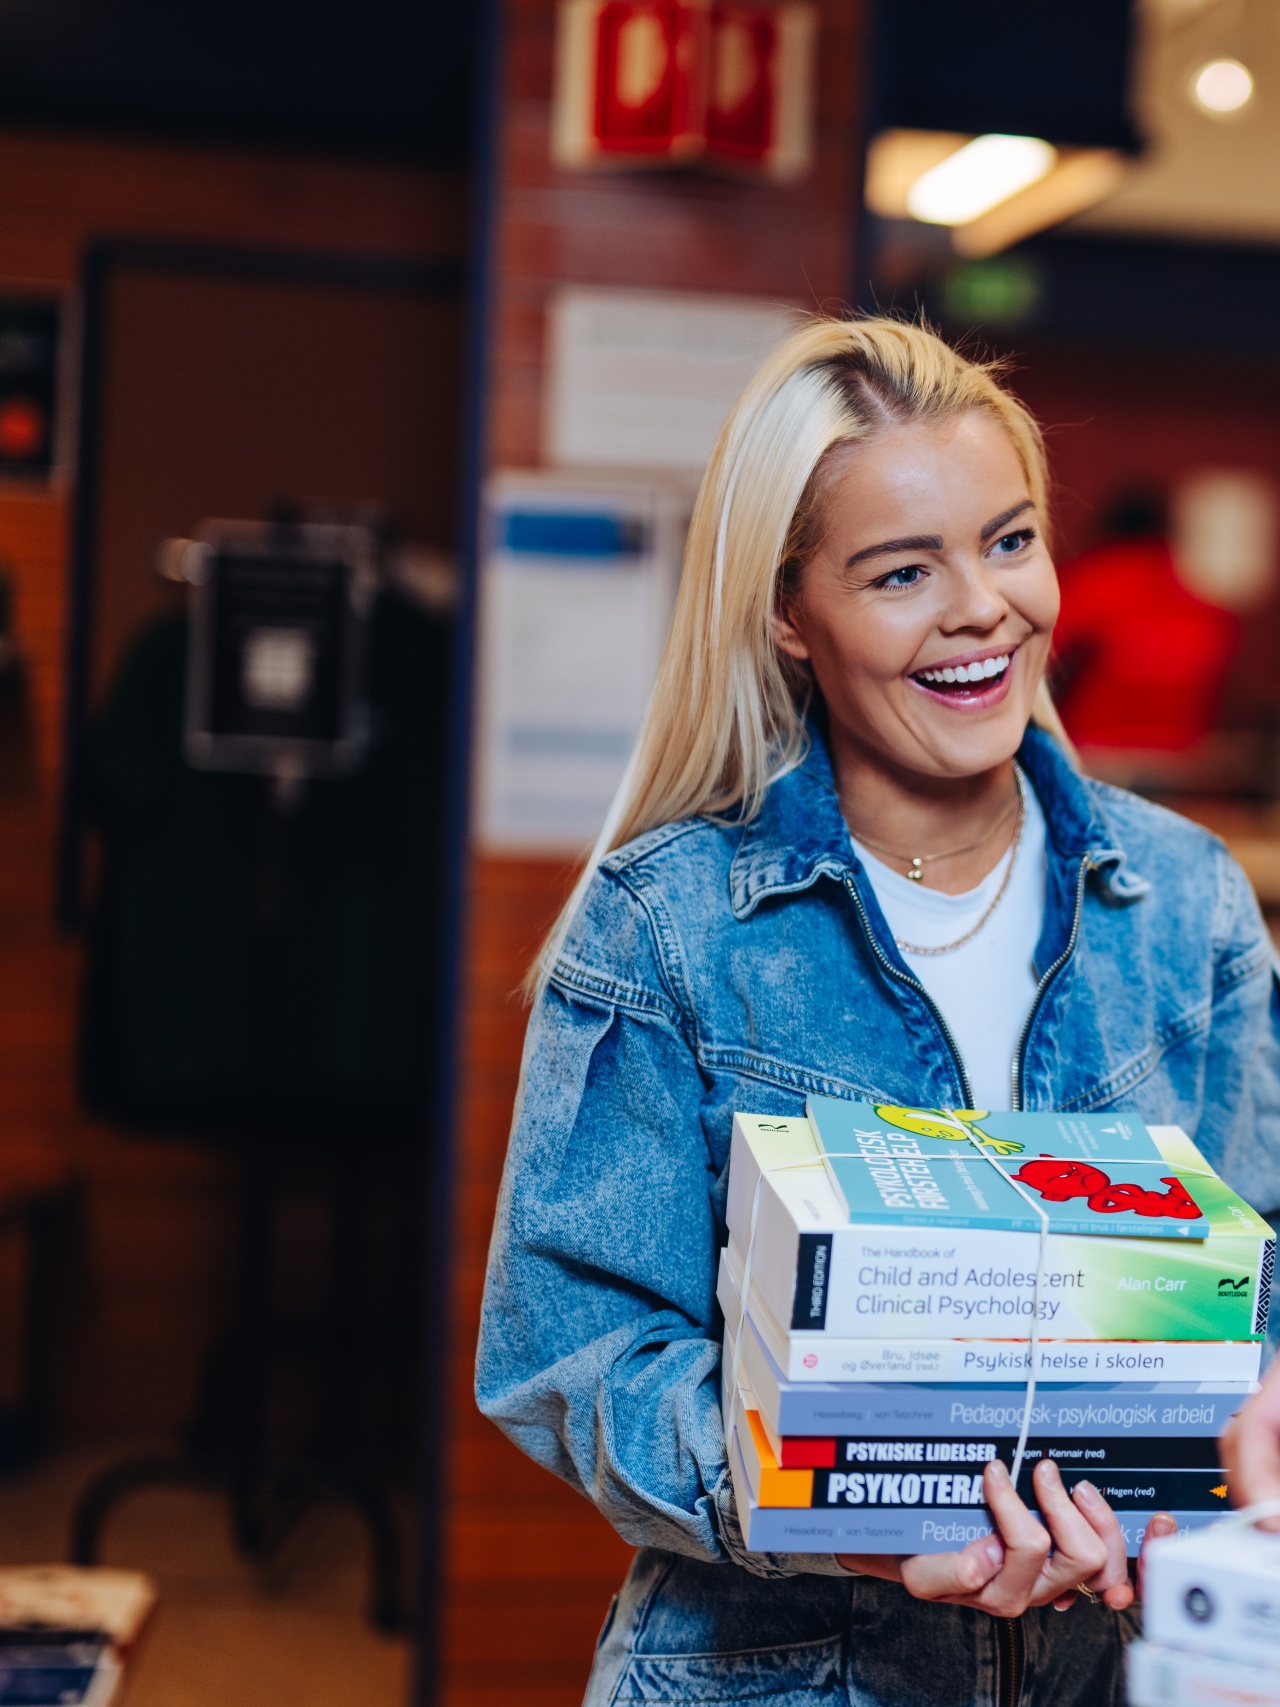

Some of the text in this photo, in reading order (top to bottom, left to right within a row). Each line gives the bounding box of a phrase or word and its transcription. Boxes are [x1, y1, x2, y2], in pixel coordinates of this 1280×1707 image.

[853, 1129, 916, 1208] PSYKOLOGISK
[887, 1133, 950, 1210] FØRSTEHELP
[1090, 1222, 1108, 1231] bruk
[861, 1246, 956, 1259] The Handbook of
[810, 1245, 827, 1318] THIRD EDITION
[858, 1266, 912, 1287] Child
[917, 1266, 959, 1287] and
[1116, 1276, 1187, 1292] Alan Carr
[856, 1294, 932, 1315] Clinical
[882, 1350, 939, 1361] Bru, Idsøe
[964, 1352, 1164, 1372] Psykisk helse i skolen
[841, 1361, 856, 1372] og
[861, 1360, 911, 1371] Øverland
[950, 1402, 1215, 1429] Pedagogsk-psykologisk arbeid
[846, 1442, 997, 1462] PSYKISKE LIDELSER
[1049, 1448, 1083, 1458] Kennair
[1085, 1448, 1105, 1459] (red)
[827, 1473, 986, 1504] PSYKOTERA
[1107, 1487, 1133, 1498] Hagen
[1134, 1486, 1155, 1498] (red)
